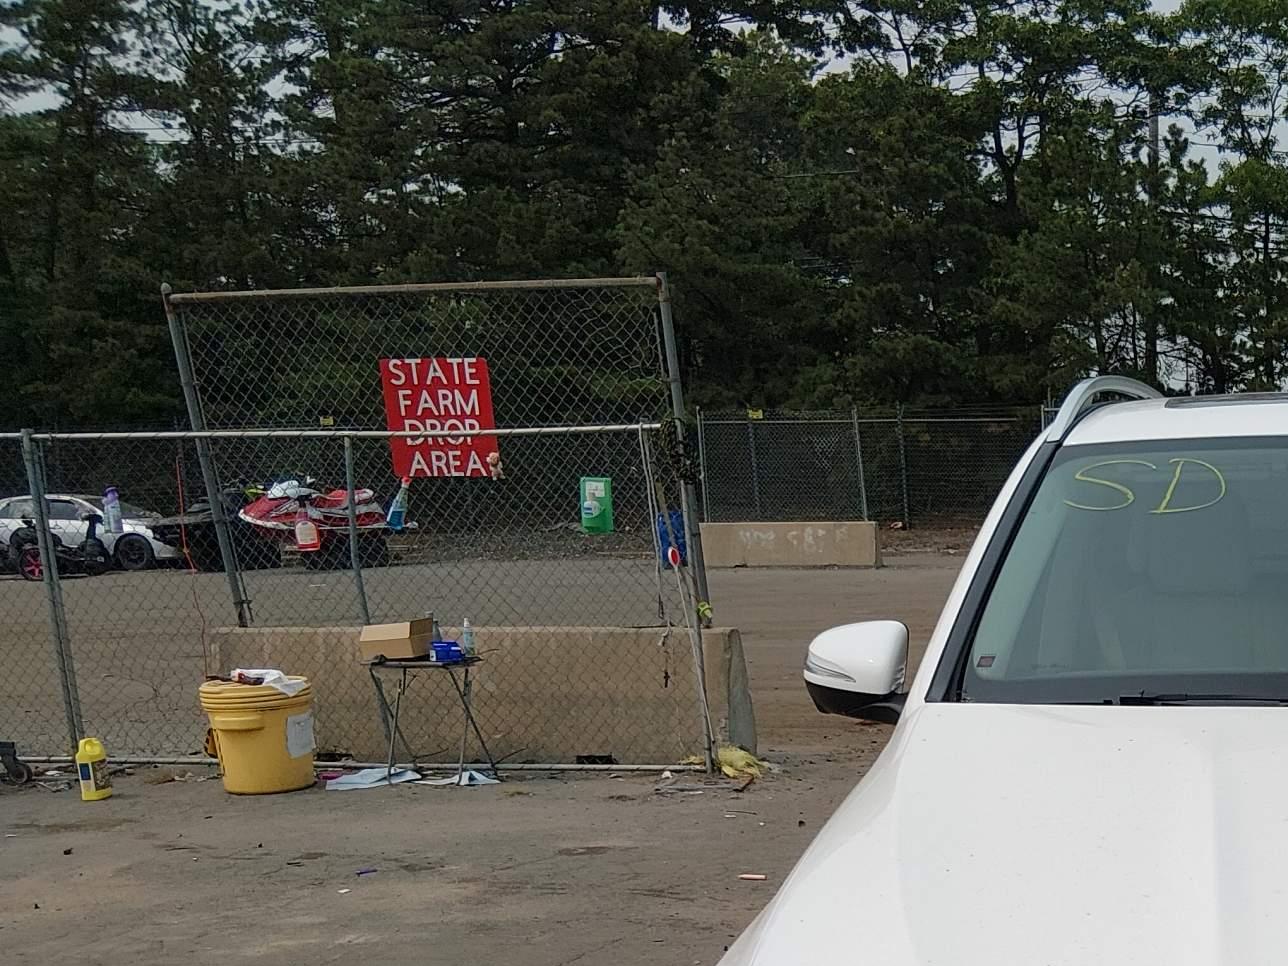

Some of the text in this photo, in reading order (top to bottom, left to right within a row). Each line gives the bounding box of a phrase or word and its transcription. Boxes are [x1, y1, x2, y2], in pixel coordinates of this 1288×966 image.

[388, 357, 480, 385] STATE
[398, 388, 480, 416] FARM
[403, 418, 480, 446] DROP
[409, 450, 488, 477] AREA
